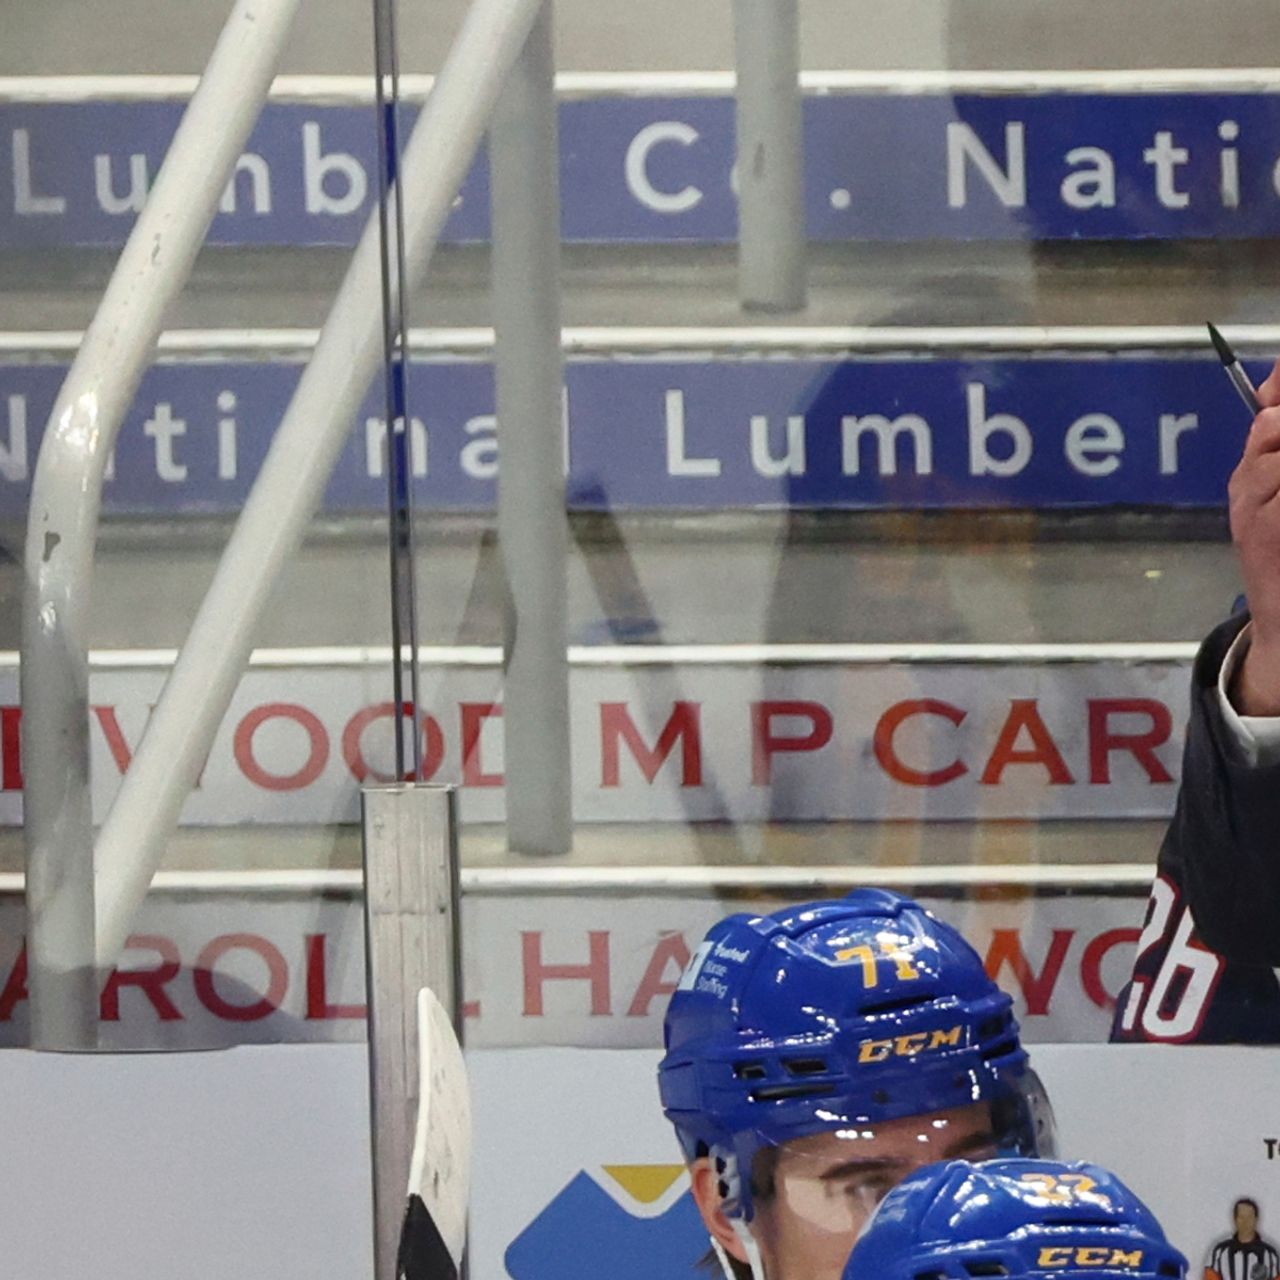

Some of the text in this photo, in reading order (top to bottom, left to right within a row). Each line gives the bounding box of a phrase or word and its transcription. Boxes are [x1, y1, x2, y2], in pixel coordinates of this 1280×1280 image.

[665, 384, 1198, 477] Lumber
[834, 942, 920, 989] 71
[858, 1025, 963, 1064] CCM
[1036, 1246, 1144, 1268] CCM
